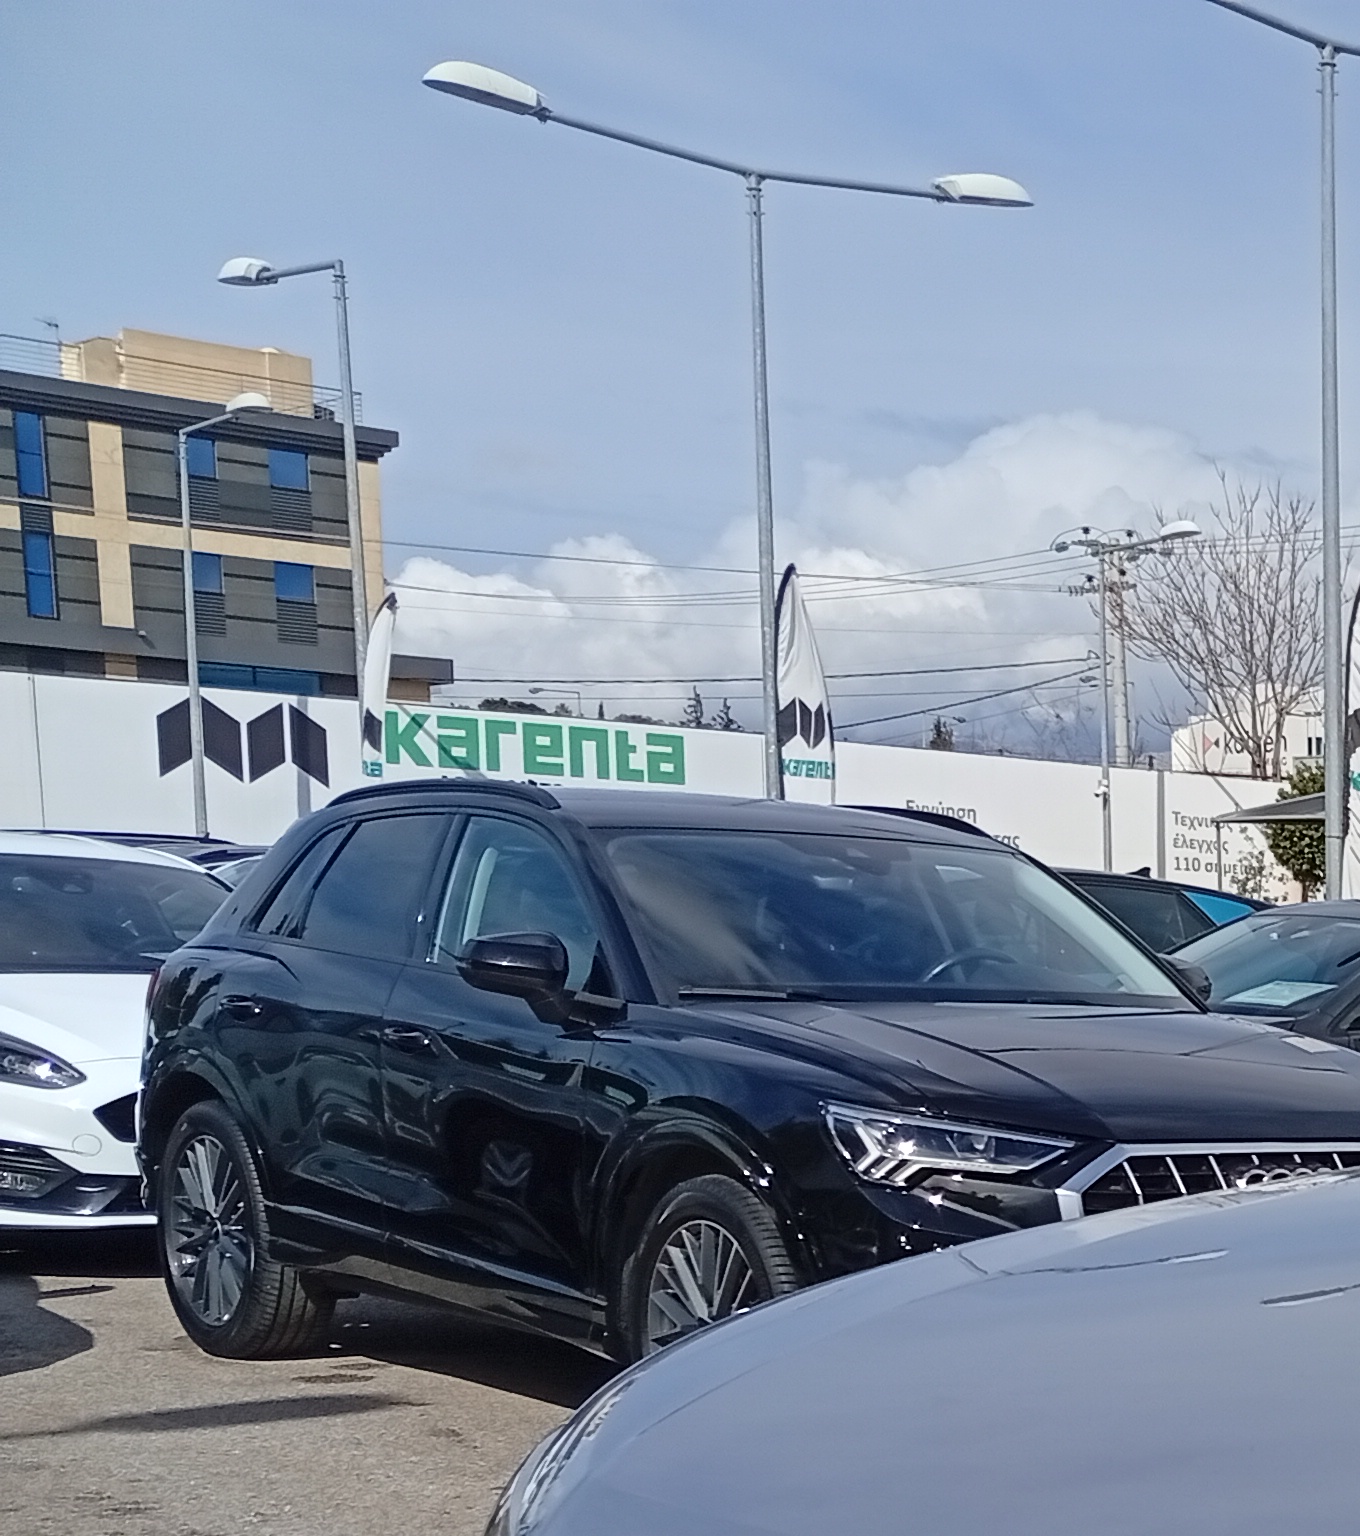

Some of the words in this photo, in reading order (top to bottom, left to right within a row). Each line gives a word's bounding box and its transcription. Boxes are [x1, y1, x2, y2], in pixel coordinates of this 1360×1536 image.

[1223, 731, 1288, 755] kaen
[1171, 810, 1234, 833] Τεχνις
[1173, 856, 1201, 873] 110
